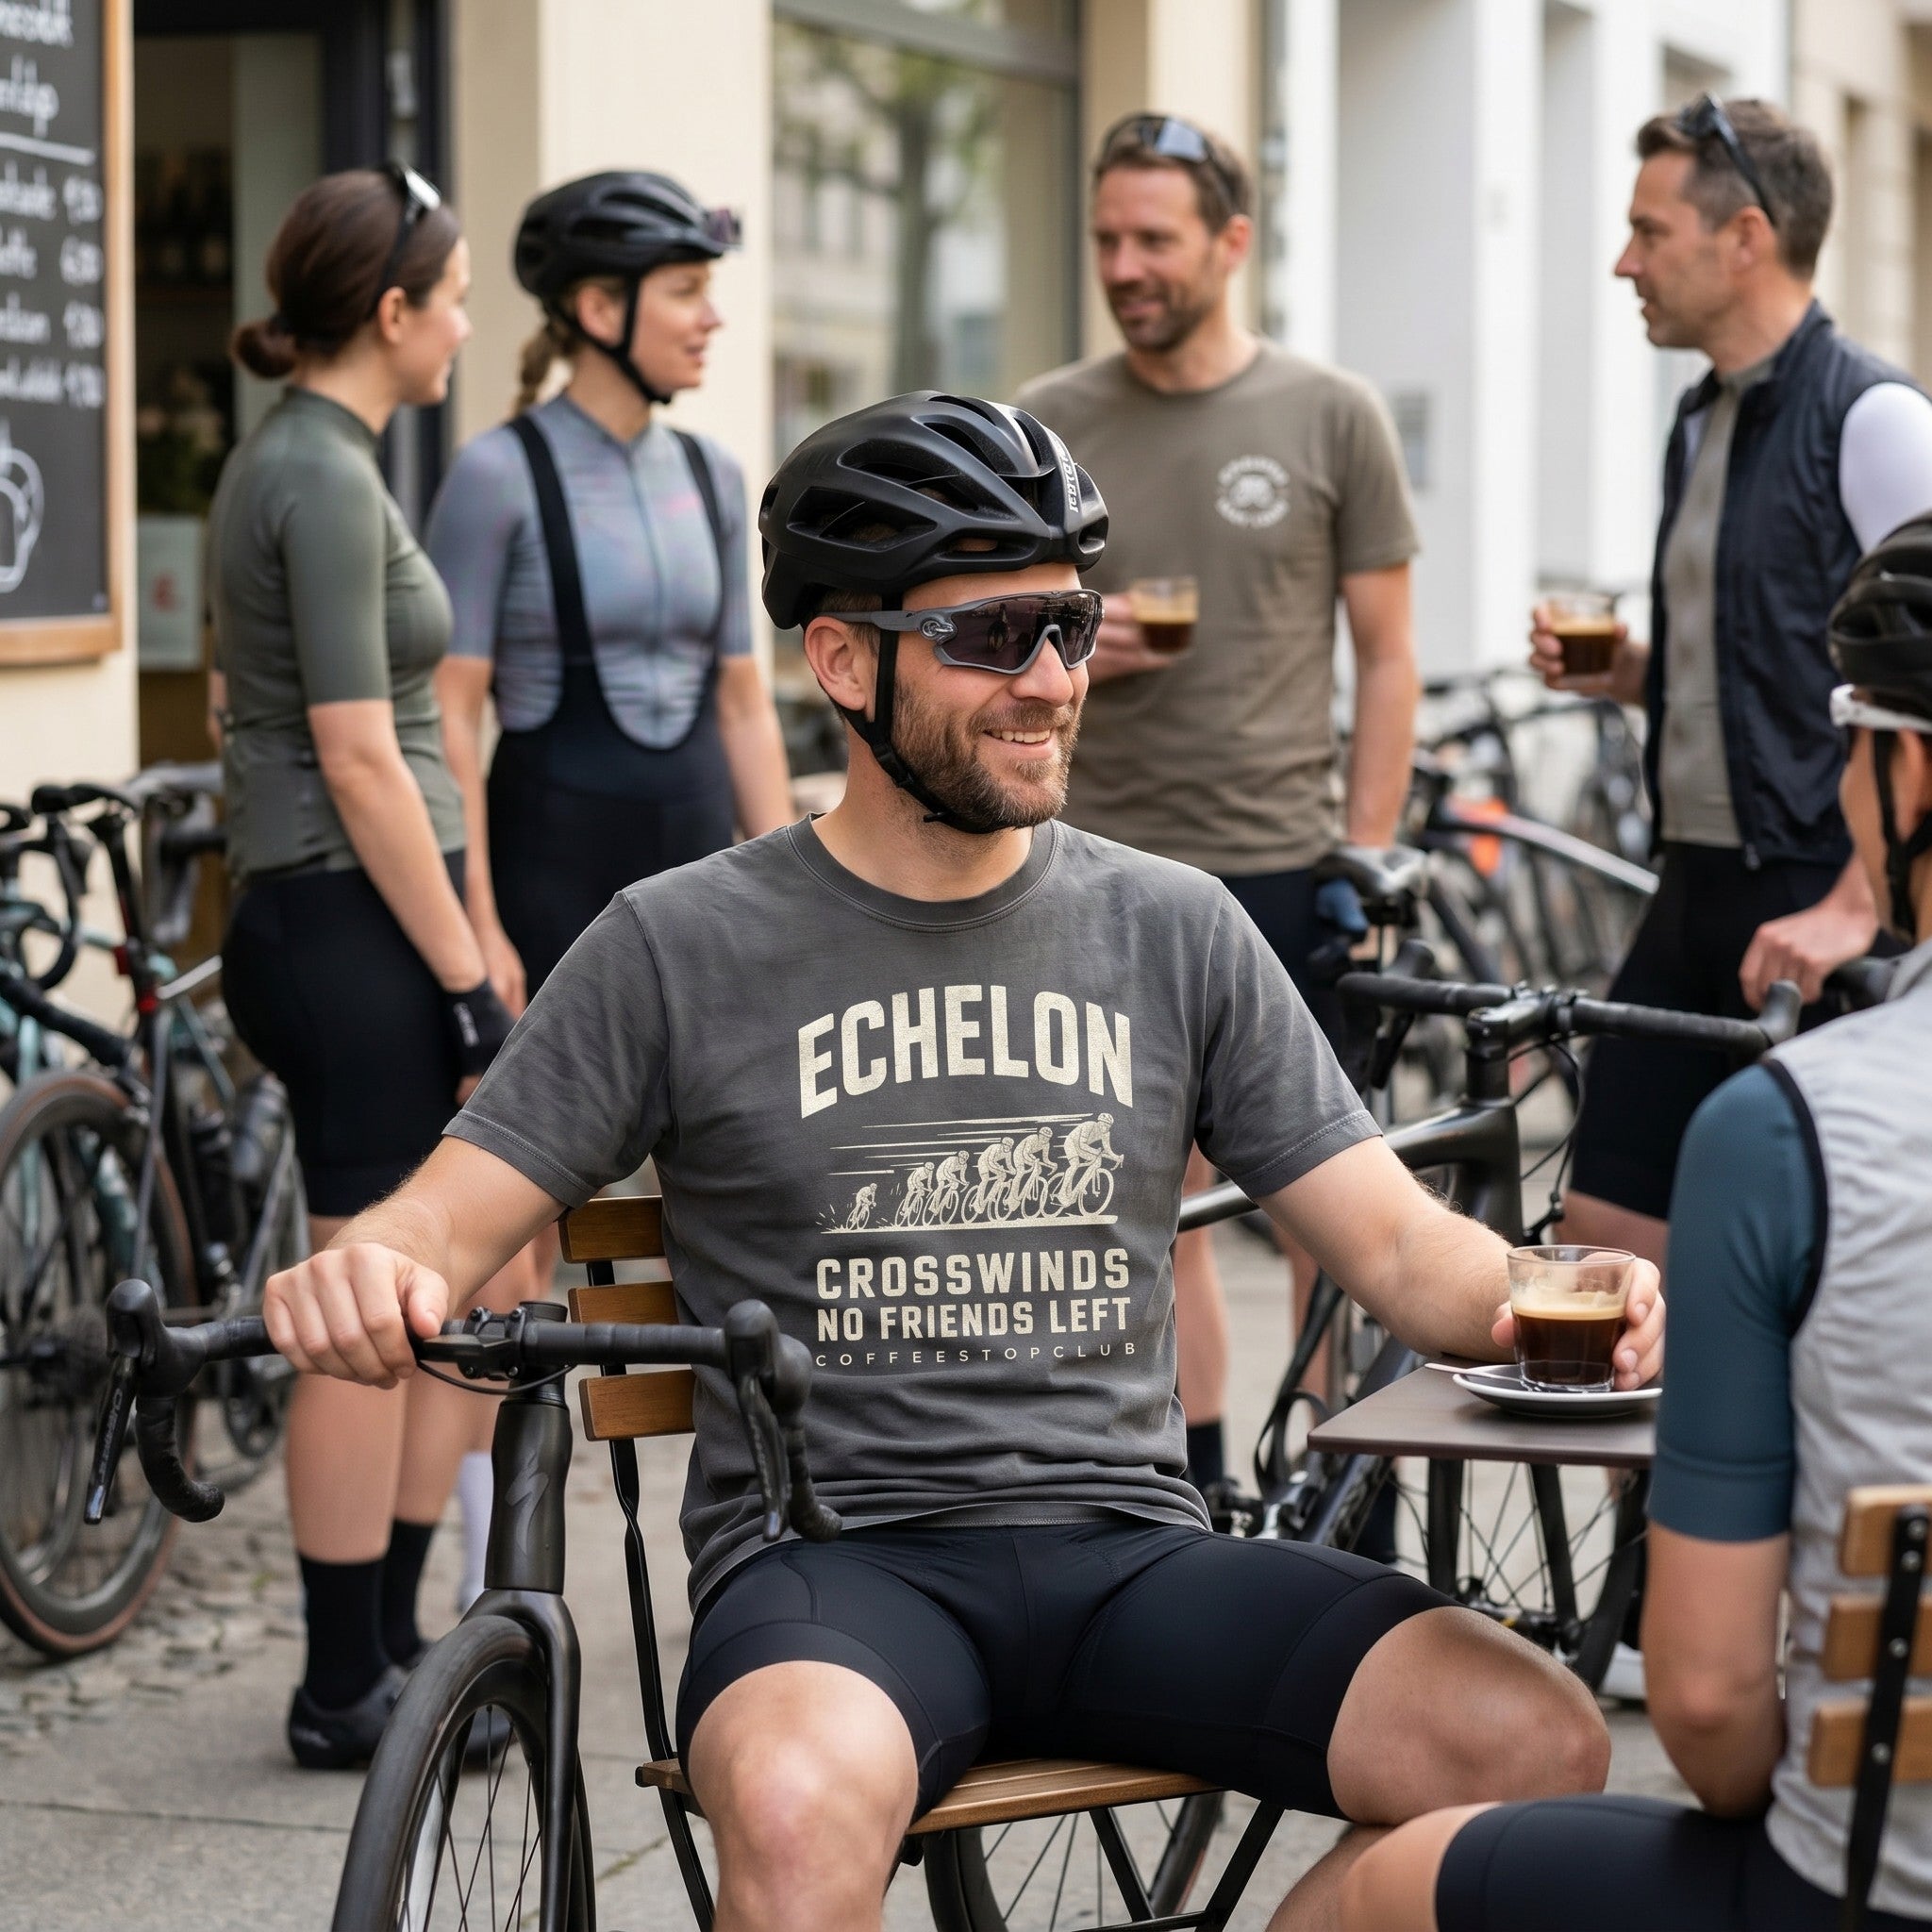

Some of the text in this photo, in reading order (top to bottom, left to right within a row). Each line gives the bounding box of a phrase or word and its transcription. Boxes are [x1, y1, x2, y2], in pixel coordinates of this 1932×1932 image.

[798, 985, 1133, 1119] ECHELON
[817, 1248, 1129, 1299] CROSSWINDS
[818, 1297, 1131, 1341] NO FRIENDS LEFT
